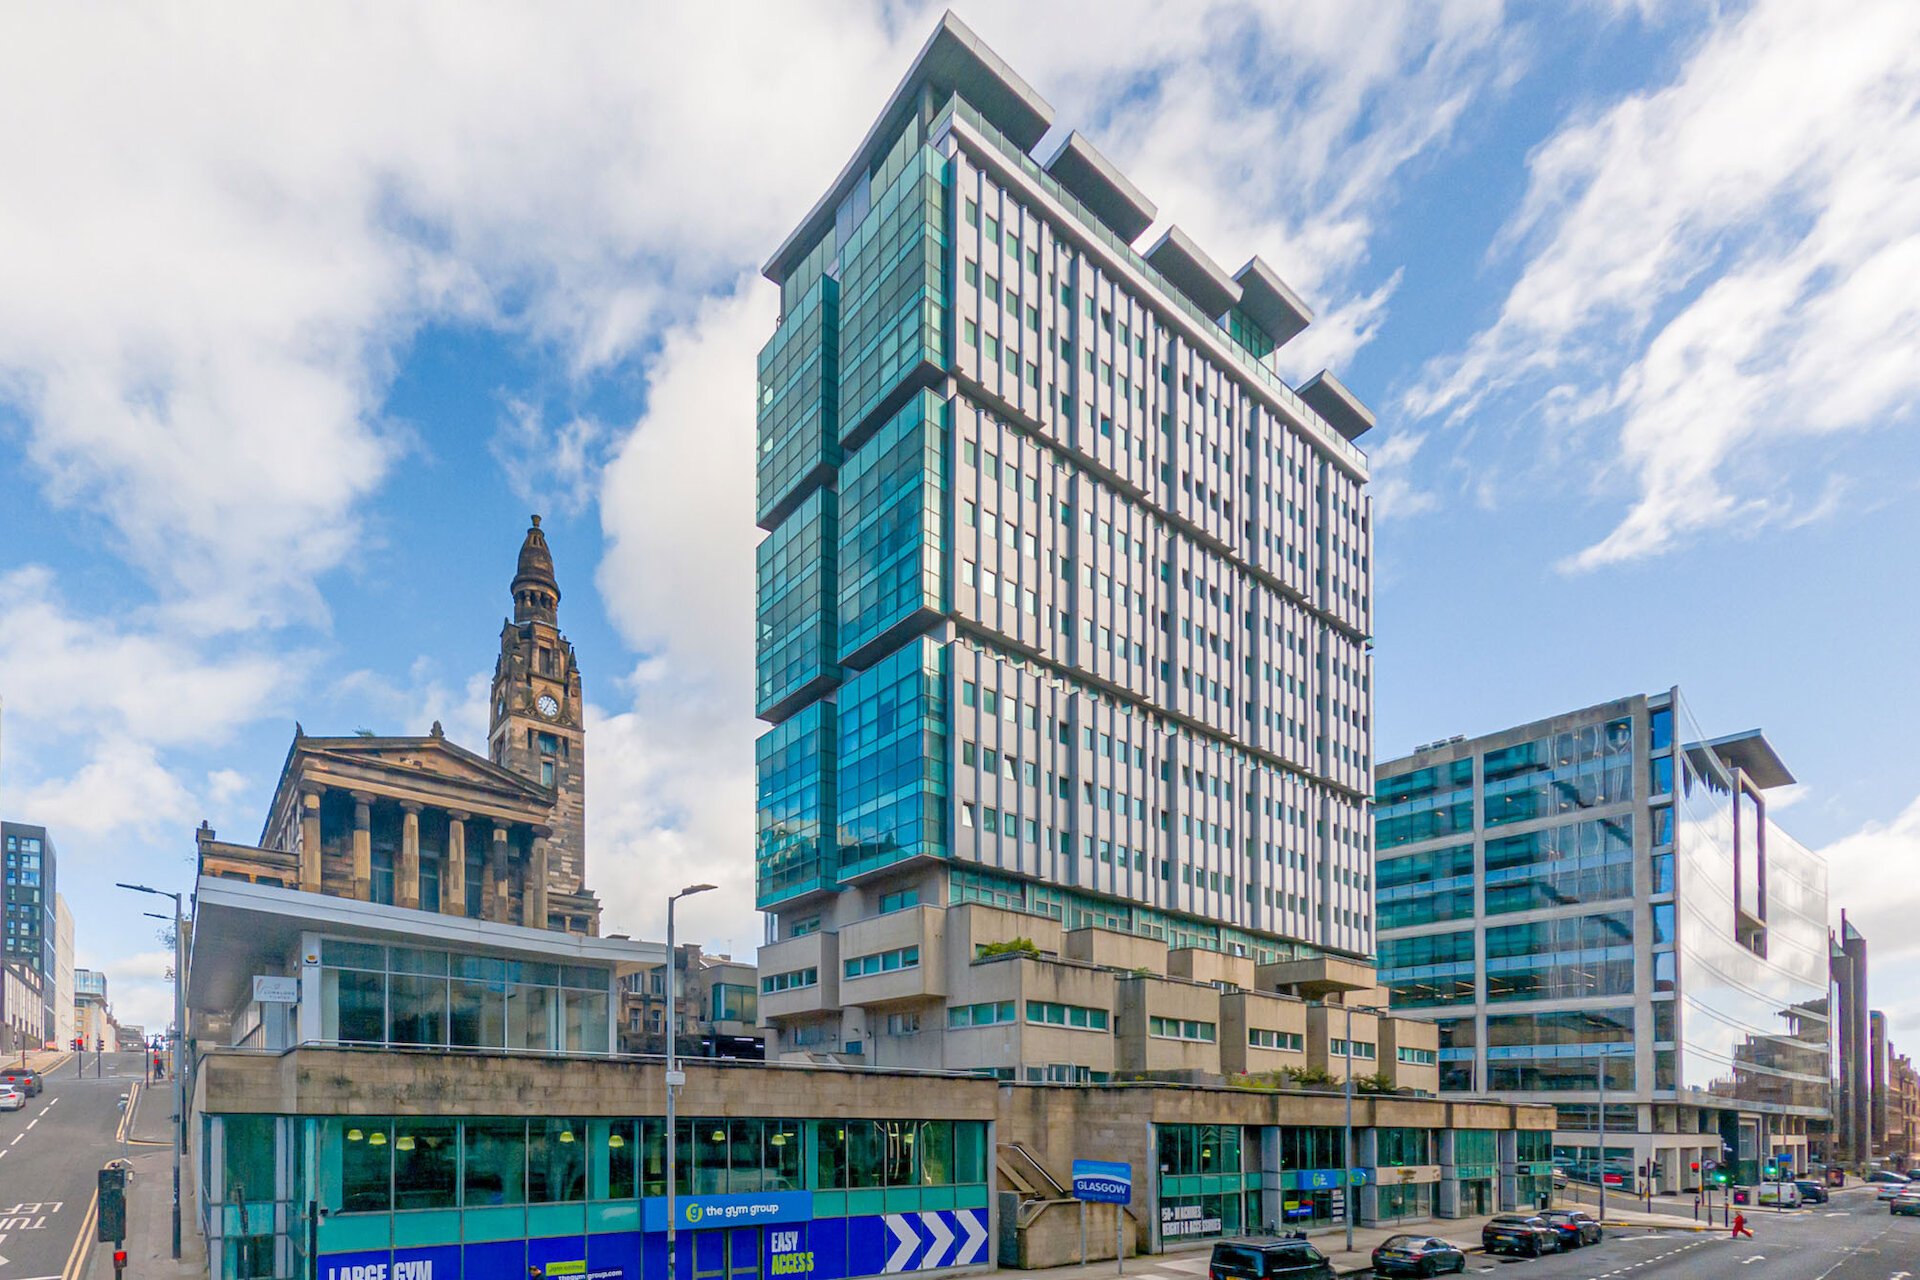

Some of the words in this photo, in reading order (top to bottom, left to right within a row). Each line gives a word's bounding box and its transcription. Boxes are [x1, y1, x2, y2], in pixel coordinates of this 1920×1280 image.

[1077, 1180, 1126, 1194] GLASGOW
[706, 1205, 723, 1217] the
[725, 1206, 748, 1218] gym
[750, 1204, 779, 1217] group
[771, 1231, 799, 1253] EASY
[393, 1260, 433, 1280] GYM
[771, 1252, 814, 1275] ACCESS
